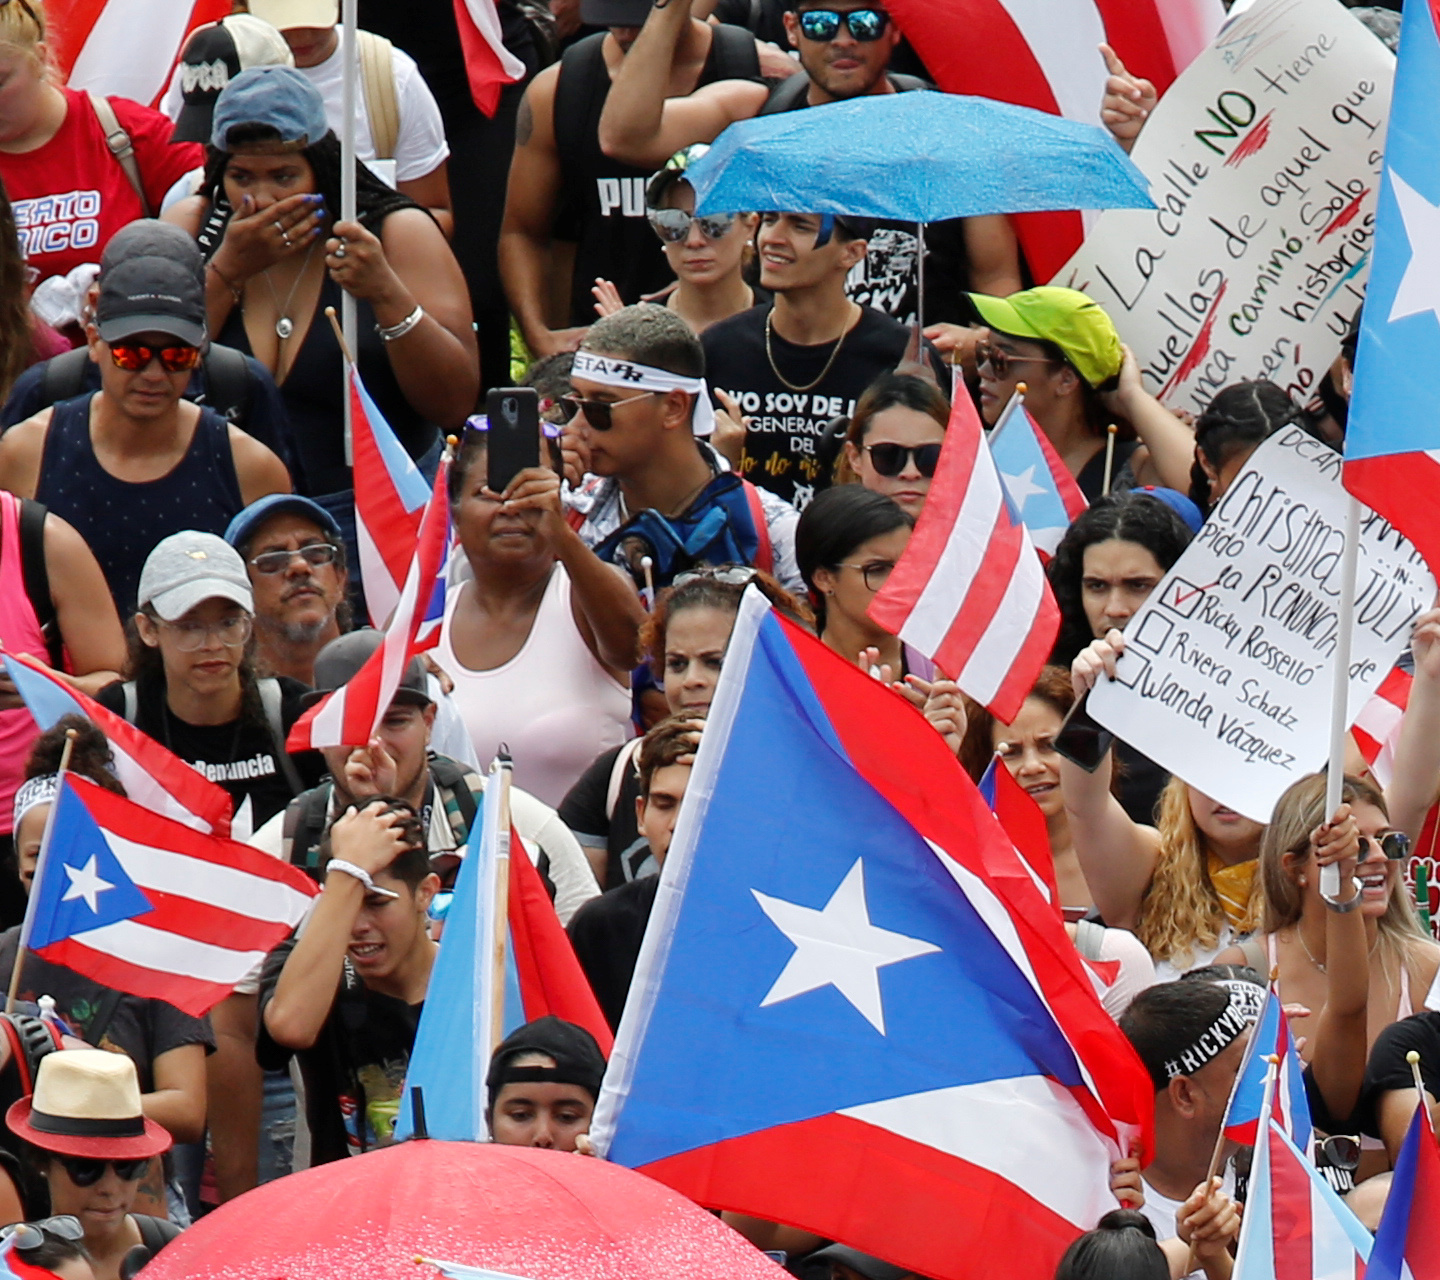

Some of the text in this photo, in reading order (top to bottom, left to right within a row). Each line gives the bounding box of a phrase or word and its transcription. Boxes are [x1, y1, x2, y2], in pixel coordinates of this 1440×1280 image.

[1096, 32, 1338, 311] La calle NO tiene
[1208, 214, 1267, 259] de
[1260, 126, 1330, 206] aquel
[1332, 79, 1382, 139] que
[1301, 178, 1365, 234] Solo
[1280, 212, 1375, 323] historias
[765, 391, 842, 417] SOY DE
[790, 437, 815, 454] DEL
[1169, 632, 1299, 733] Rivera Schatz
[1197, 594, 1324, 686] Ricky Rosselló
[1140, 667, 1297, 772] Wanda Vázquez
